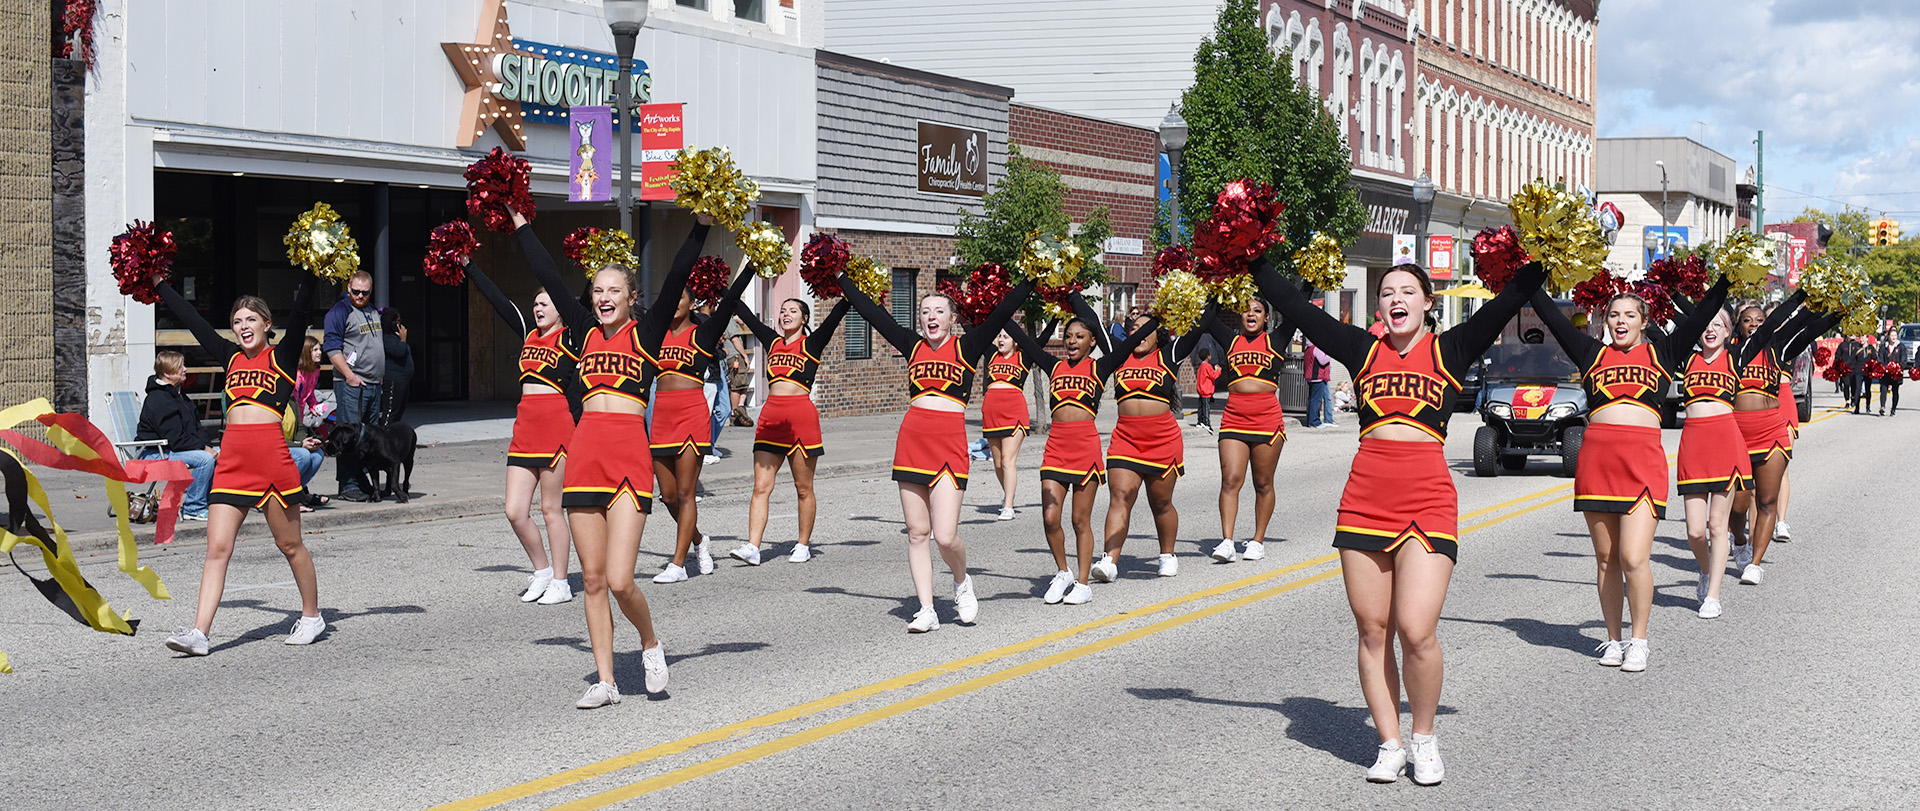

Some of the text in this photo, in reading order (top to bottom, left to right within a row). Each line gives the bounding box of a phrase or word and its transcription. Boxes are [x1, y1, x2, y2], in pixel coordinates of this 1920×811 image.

[499, 53, 652, 115] SHOOTES
[645, 150, 663, 161] Blue
[921, 143, 961, 191] Family
[649, 174, 669, 182] Festival
[928, 176, 986, 191] Chiropractic Health Center
[1363, 204, 1410, 235] MARKET
[521, 347, 559, 369] ERRIS
[580, 352, 642, 382] ERRIS
[1360, 372, 1443, 410] FERRIS
[1592, 365, 1658, 396] FERRIS
